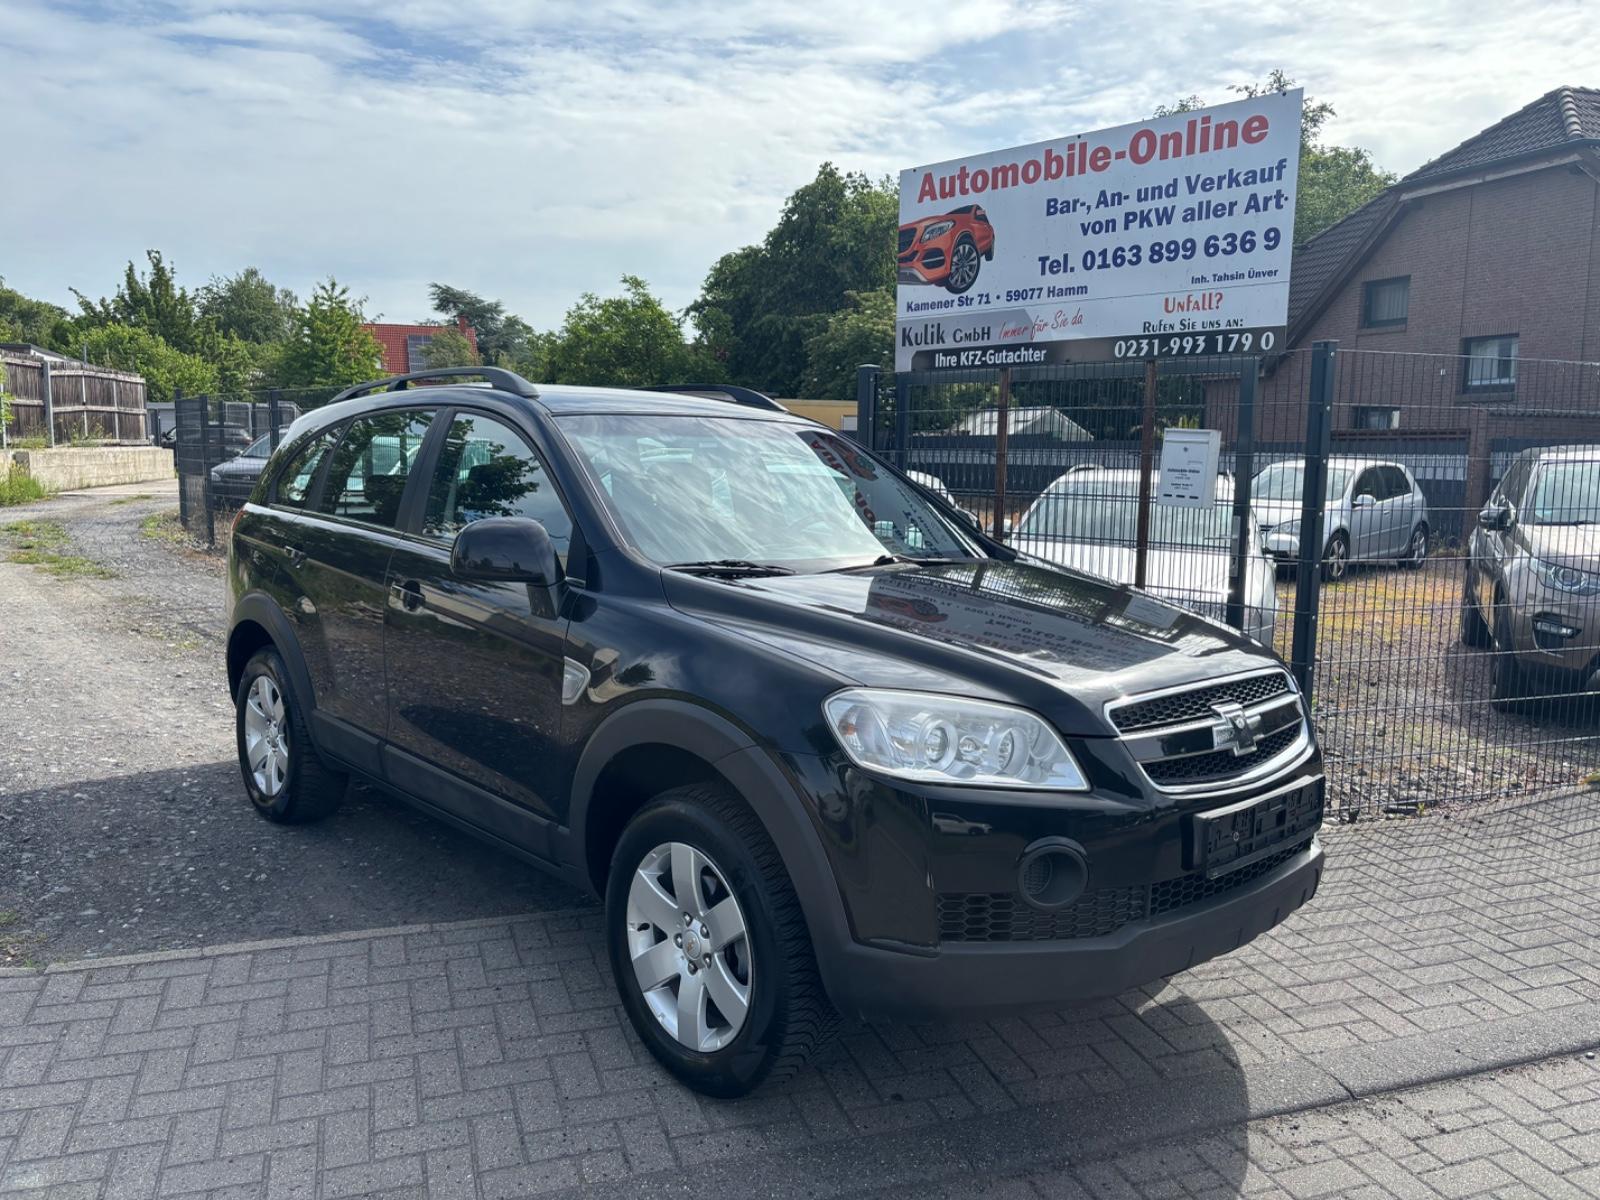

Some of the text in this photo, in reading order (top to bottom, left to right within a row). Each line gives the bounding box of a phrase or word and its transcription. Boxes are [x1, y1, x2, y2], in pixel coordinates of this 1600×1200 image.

[917, 114, 1270, 203] Automobile-Online
[1046, 158, 1287, 216] Bar-, An- und Verkauf
[1080, 217, 1117, 236] von
[1123, 205, 1176, 231] PKW
[1182, 199, 1238, 223] aller
[1038, 227, 1281, 276] Tel. 0163 899 636 9
[1190, 267, 1279, 285] Inh. Tahsin Ünver
[906, 285, 1088, 312] Kamener Str 71 59077 Hamm
[901, 322, 946, 347] Kulik
[999, 307, 1083, 341] Immer für Sie da
[935, 347, 1047, 367] Ihre KFZ-Gutachter
[1114, 331, 1275, 358] 0231-993 179 0
